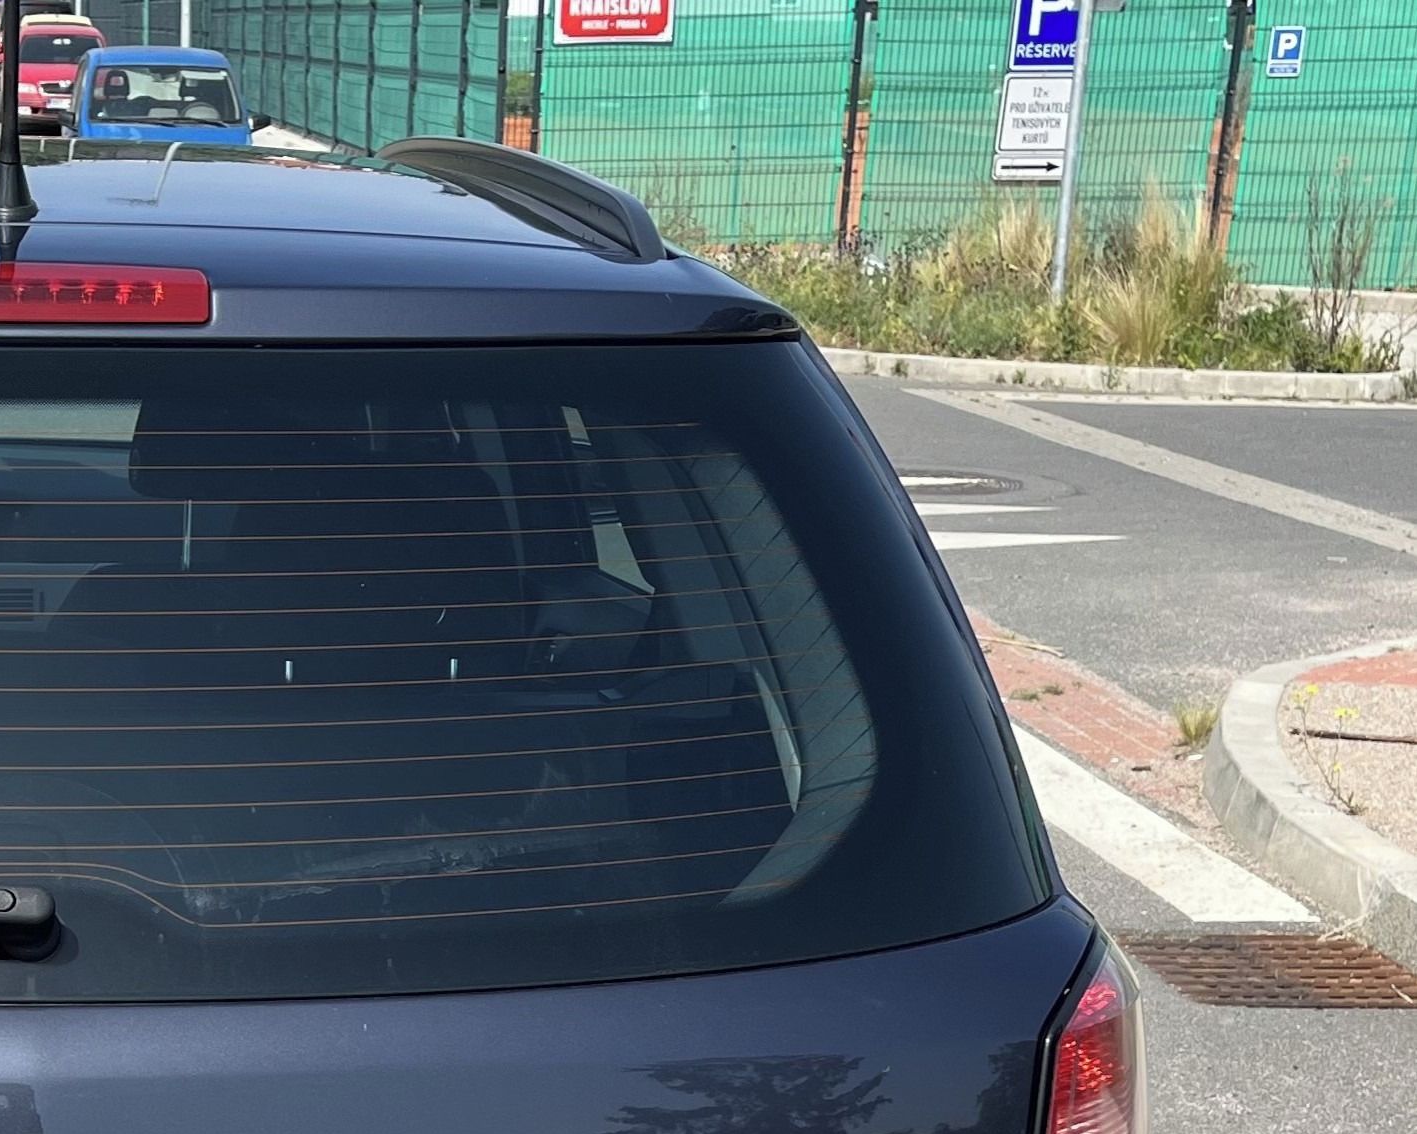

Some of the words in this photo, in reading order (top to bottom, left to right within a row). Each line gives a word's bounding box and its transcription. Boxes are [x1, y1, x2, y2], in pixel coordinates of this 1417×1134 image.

[1277, 33, 1298, 58] P
[1009, 102, 1026, 113] PRO
[1012, 116, 1061, 129] TENISOVÝCH
